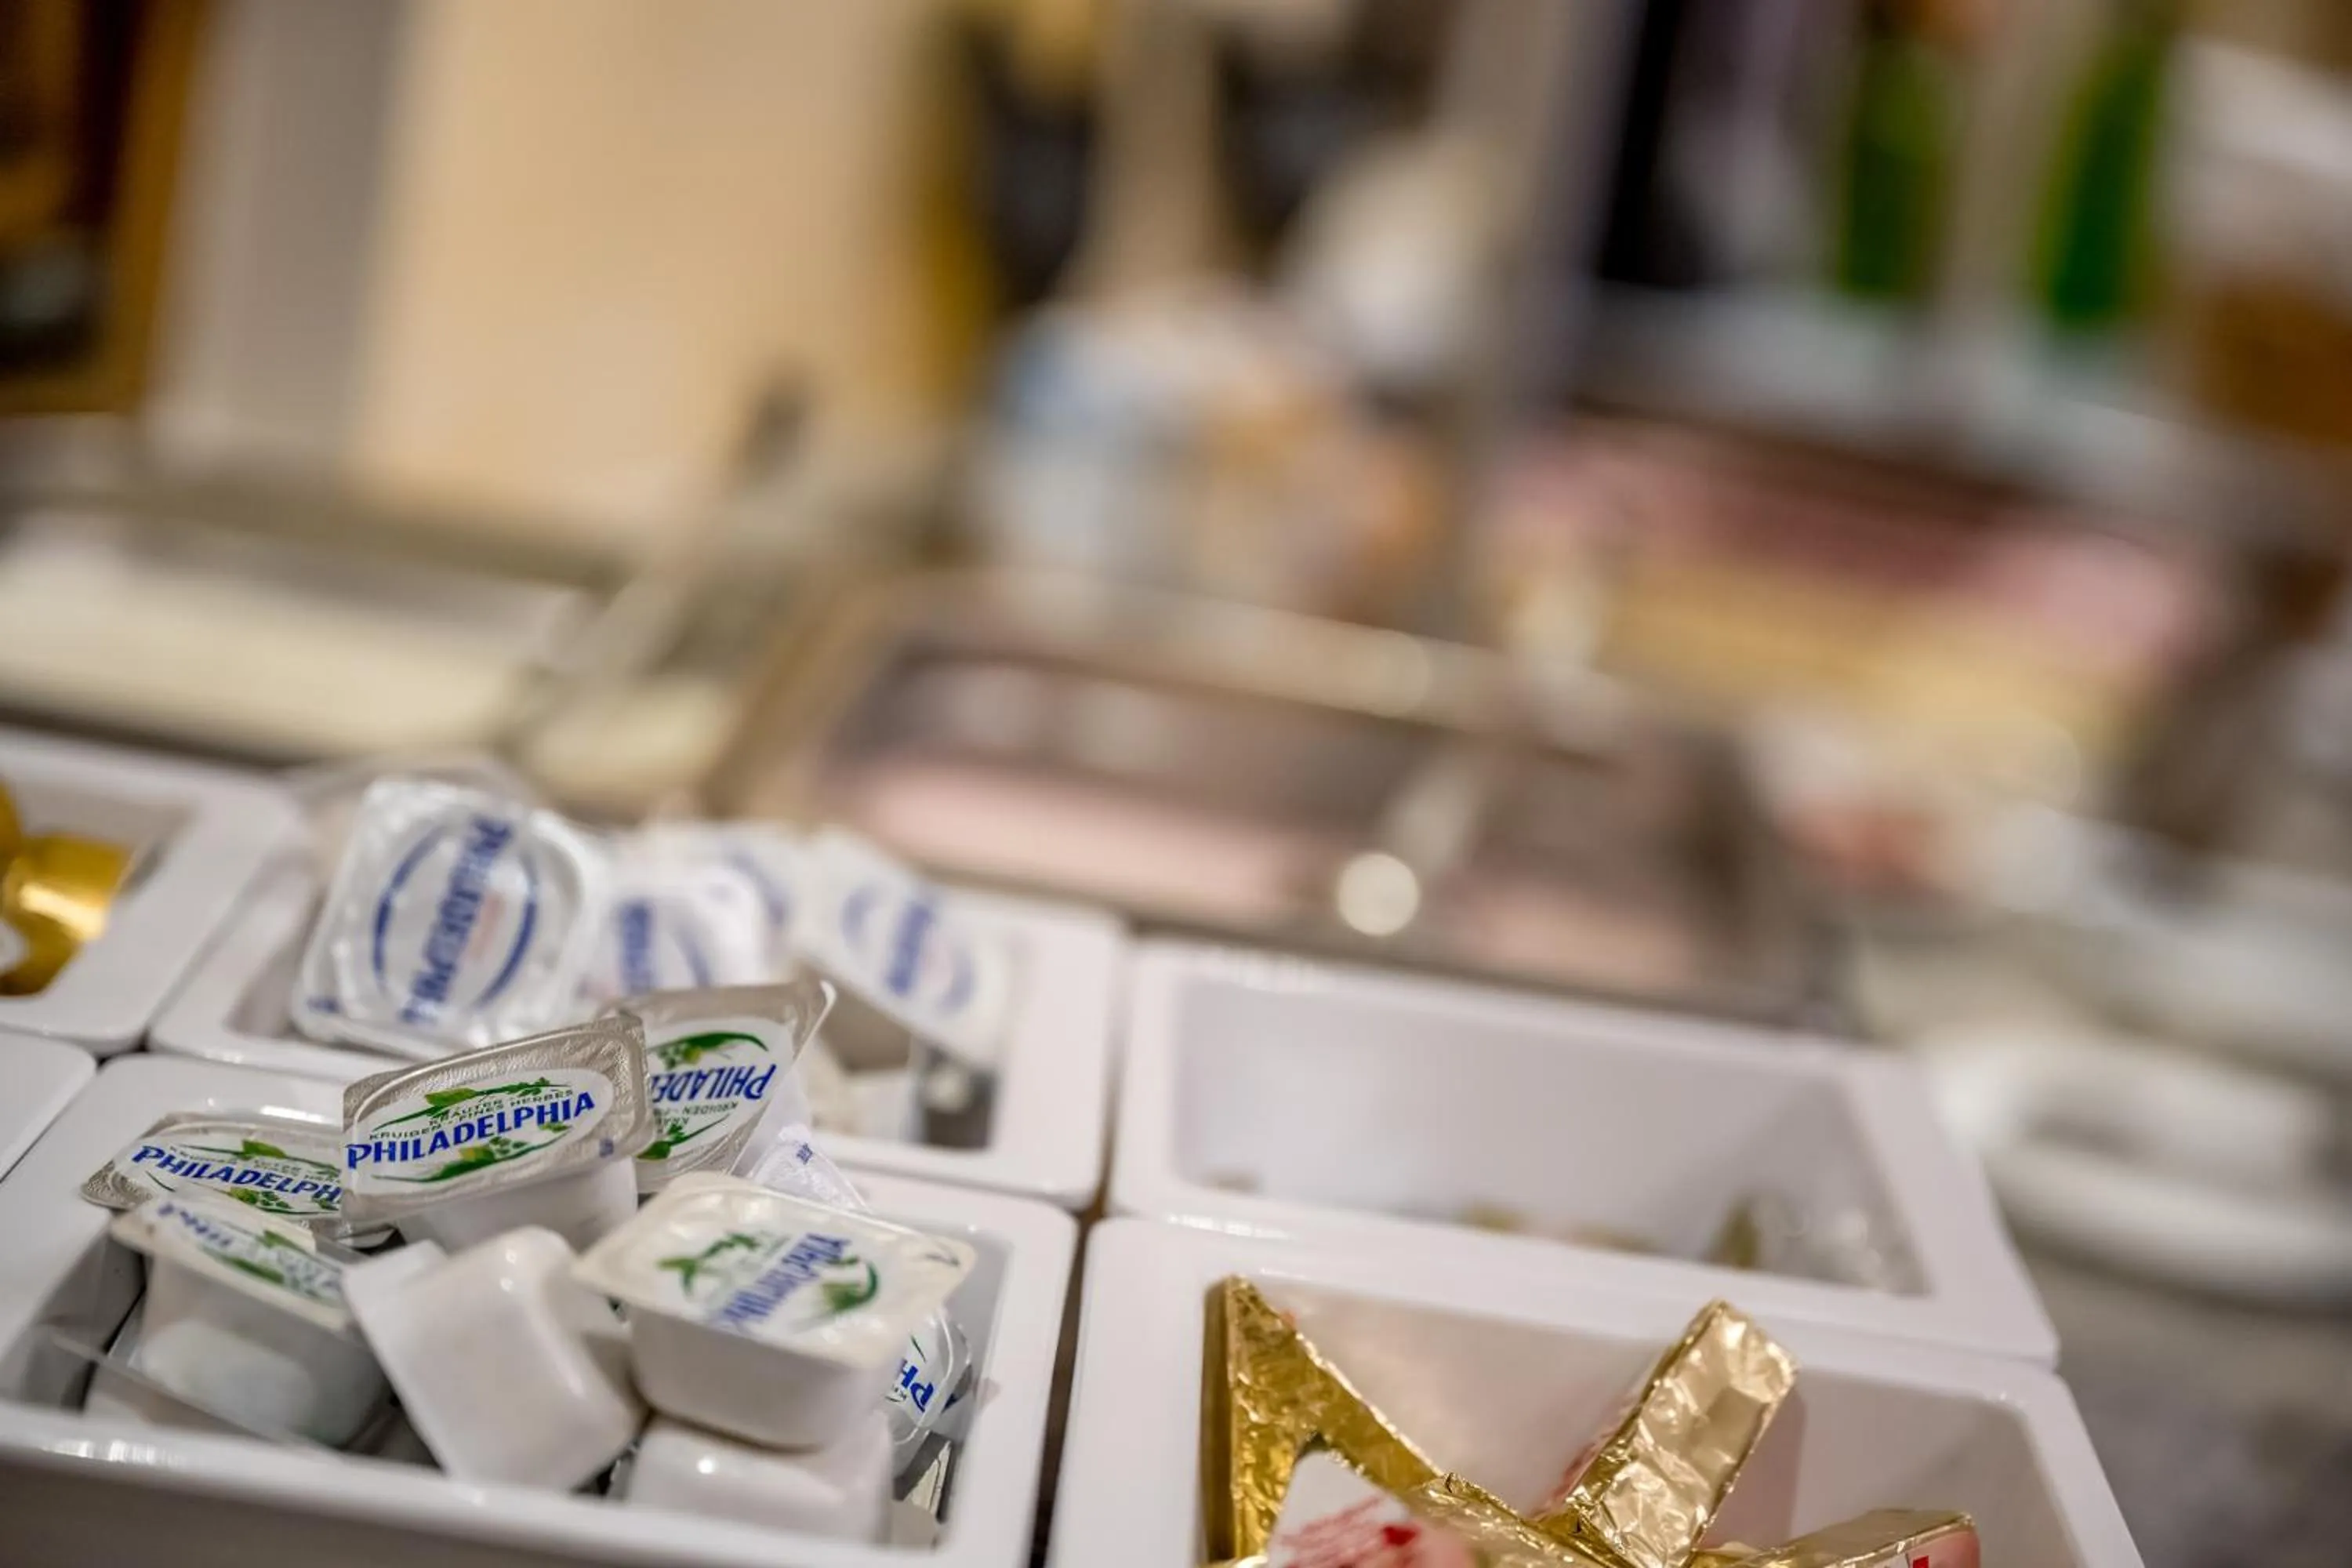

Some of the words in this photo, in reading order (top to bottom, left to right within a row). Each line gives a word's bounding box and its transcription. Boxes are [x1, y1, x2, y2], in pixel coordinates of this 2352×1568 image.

[651, 1064, 777, 1103] PHILADE
[344, 1091, 595, 1170] PHILADELPHIA
[132, 1145, 343, 1203] PHILADELPH
